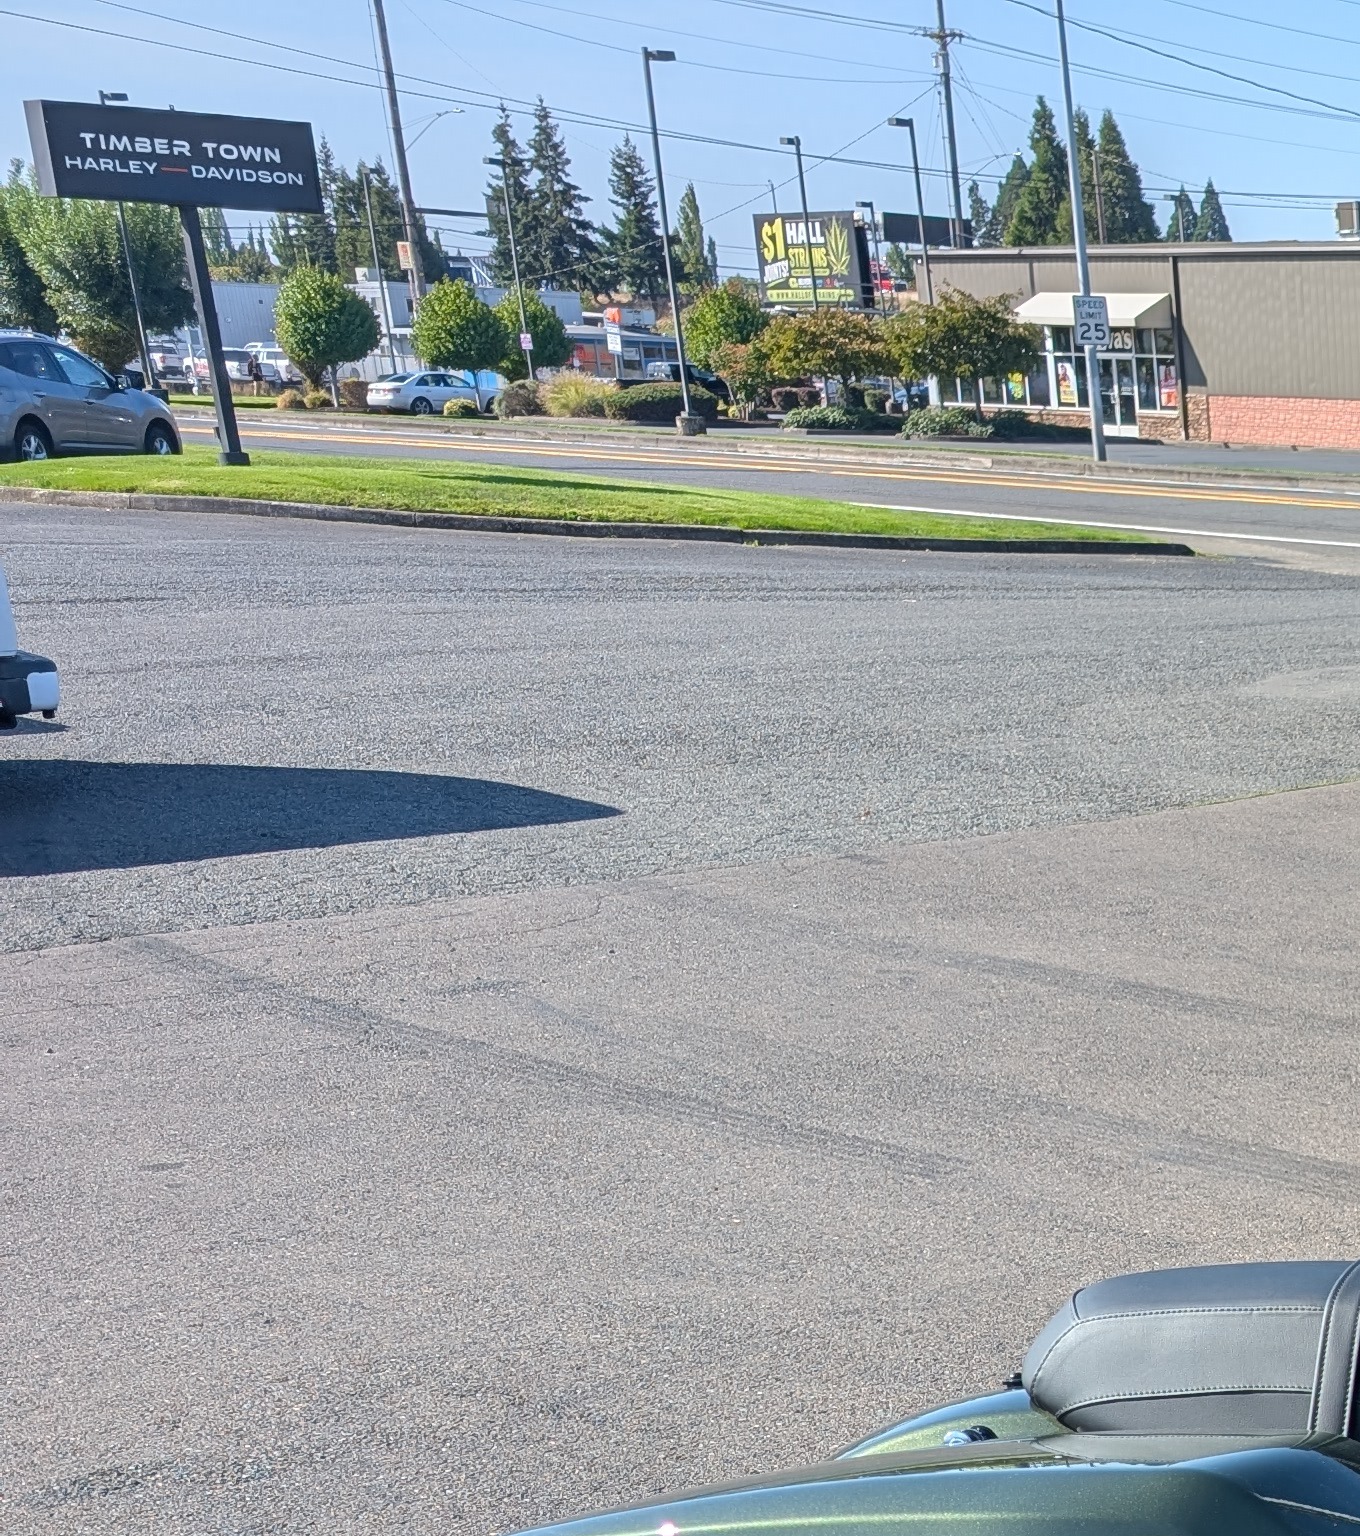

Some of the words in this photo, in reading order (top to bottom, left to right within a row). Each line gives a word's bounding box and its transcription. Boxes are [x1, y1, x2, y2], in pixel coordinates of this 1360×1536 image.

[80, 132, 191, 156] TIMBER
[202, 142, 281, 164] TOWN
[762, 217, 785, 263] $1
[785, 222, 825, 244] HALL
[788, 247, 828, 268] STRINS
[1076, 299, 1105, 309] SPEED
[1079, 311, 1102, 320] LIMIT
[1079, 322, 1106, 341] 25
